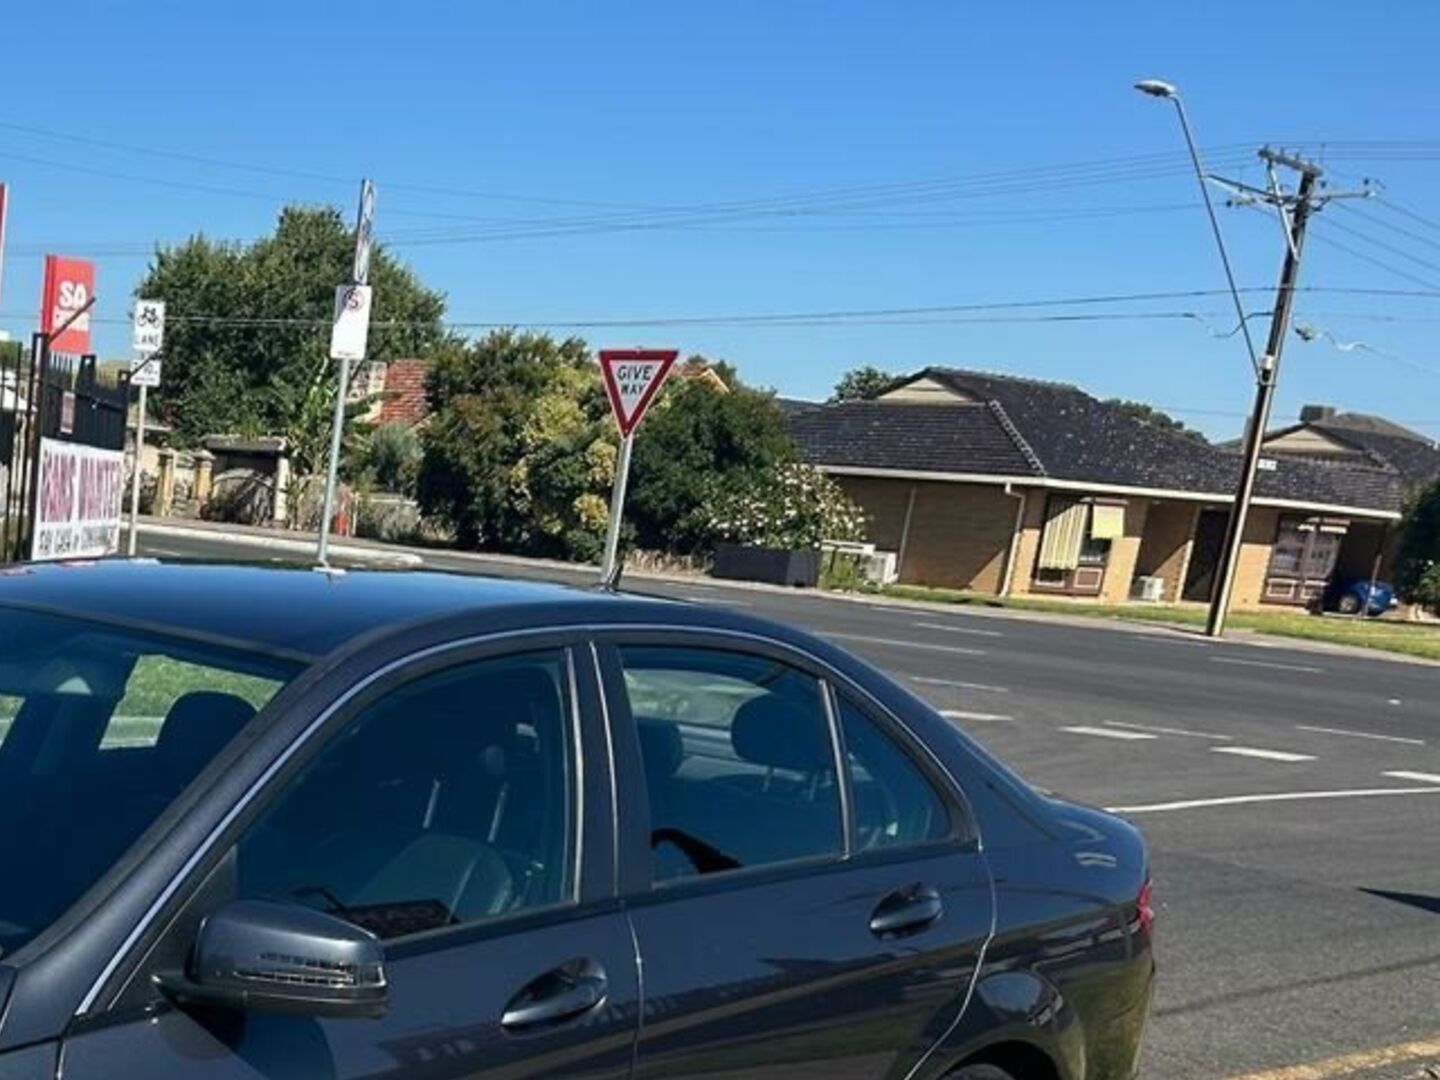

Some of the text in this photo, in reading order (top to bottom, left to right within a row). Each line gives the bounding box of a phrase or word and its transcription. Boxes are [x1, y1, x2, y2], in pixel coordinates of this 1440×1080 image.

[59, 280, 87, 309] SA
[618, 365, 653, 380] GIVE
[620, 382, 647, 396] WAY
